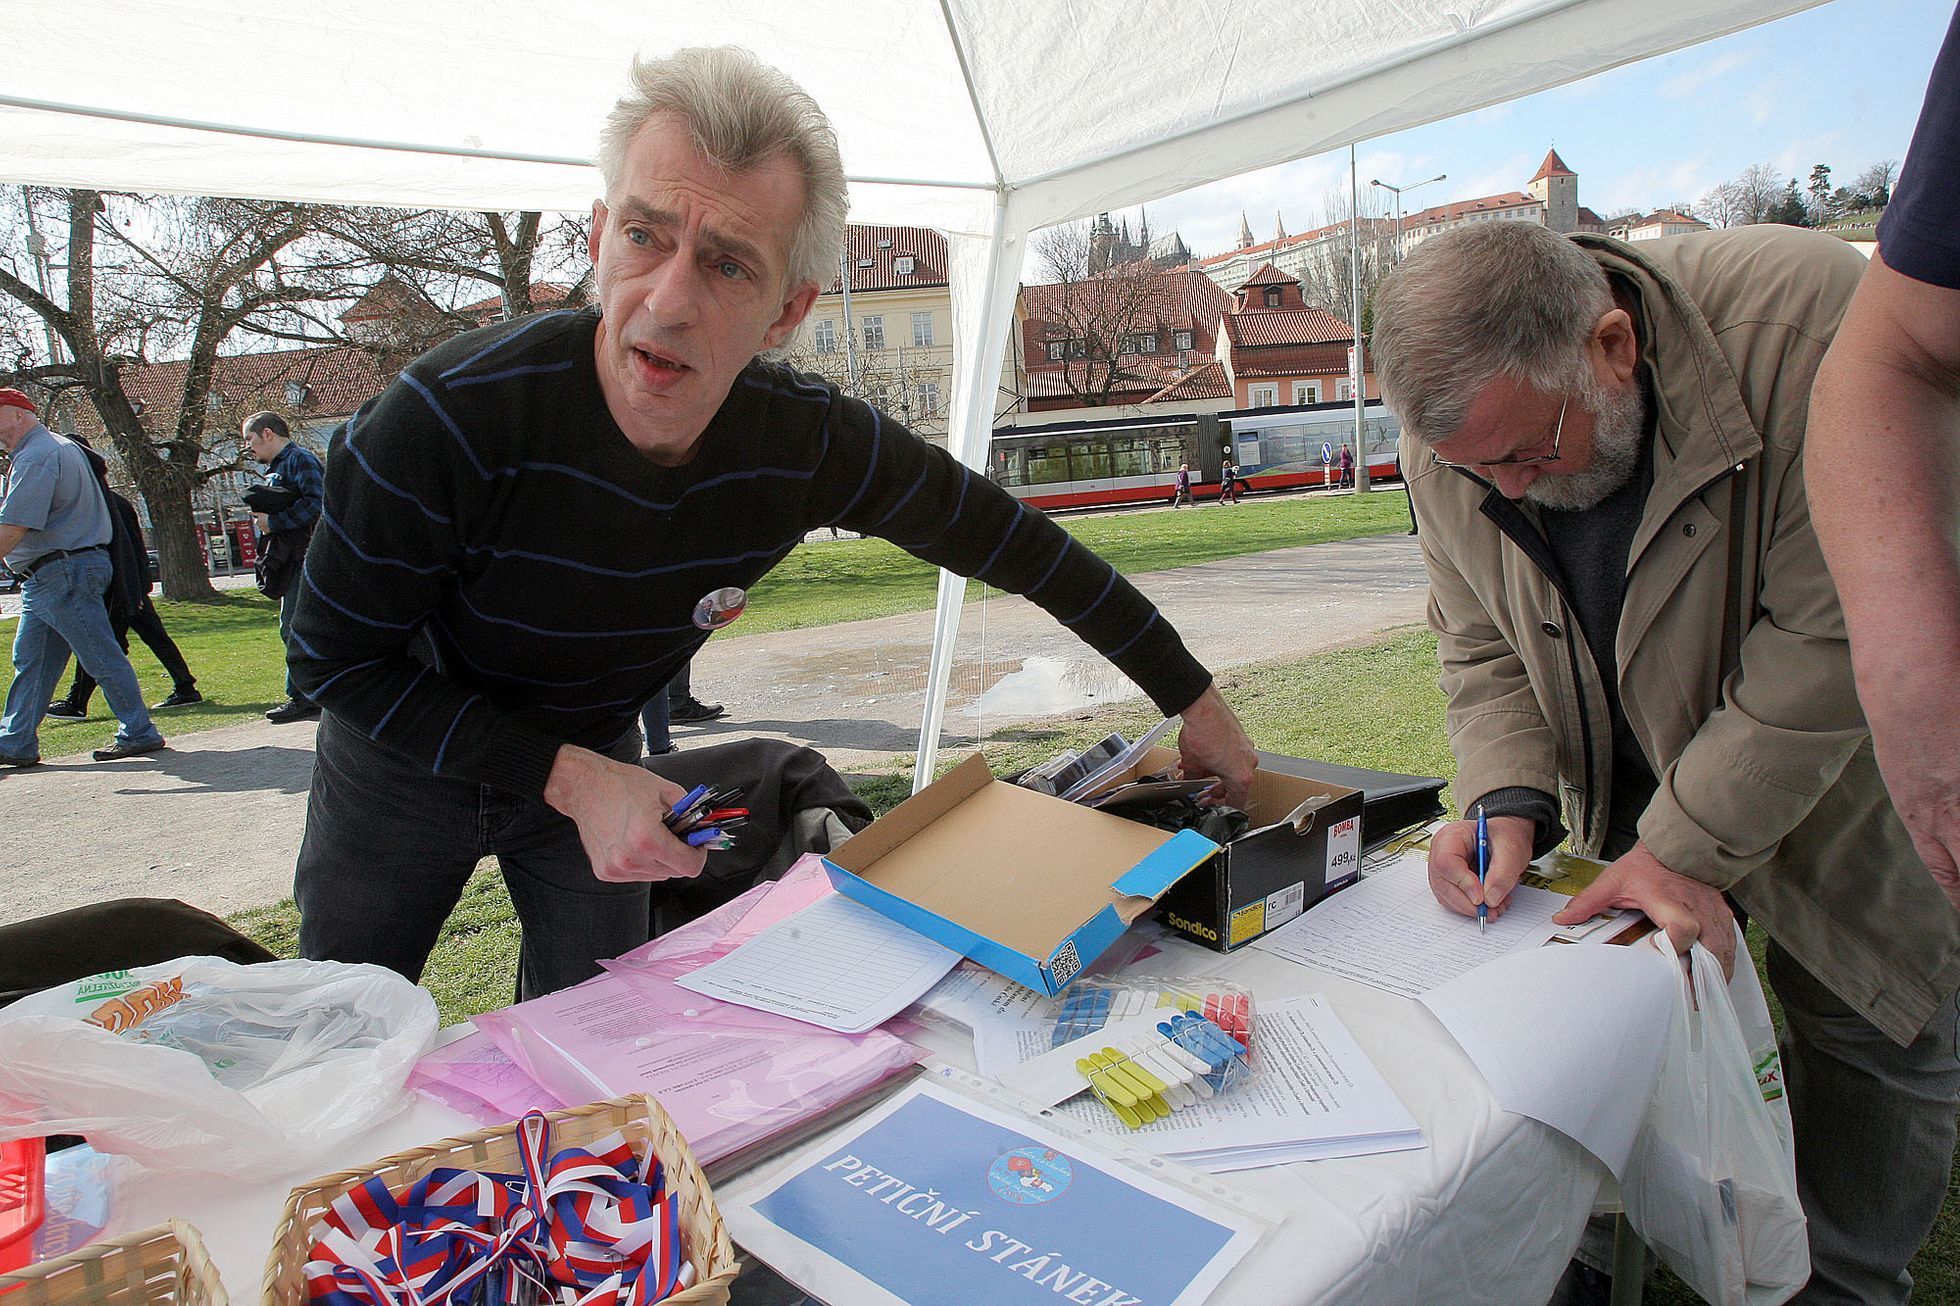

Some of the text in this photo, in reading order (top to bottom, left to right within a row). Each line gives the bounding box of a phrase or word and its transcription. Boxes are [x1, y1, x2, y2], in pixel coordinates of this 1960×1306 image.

[1333, 819, 1354, 838] BOMBA
[1168, 912, 1217, 941] Sondico
[822, 1154, 981, 1235] PETIČNÍ
[965, 1230, 1142, 1306] STÁNEK
